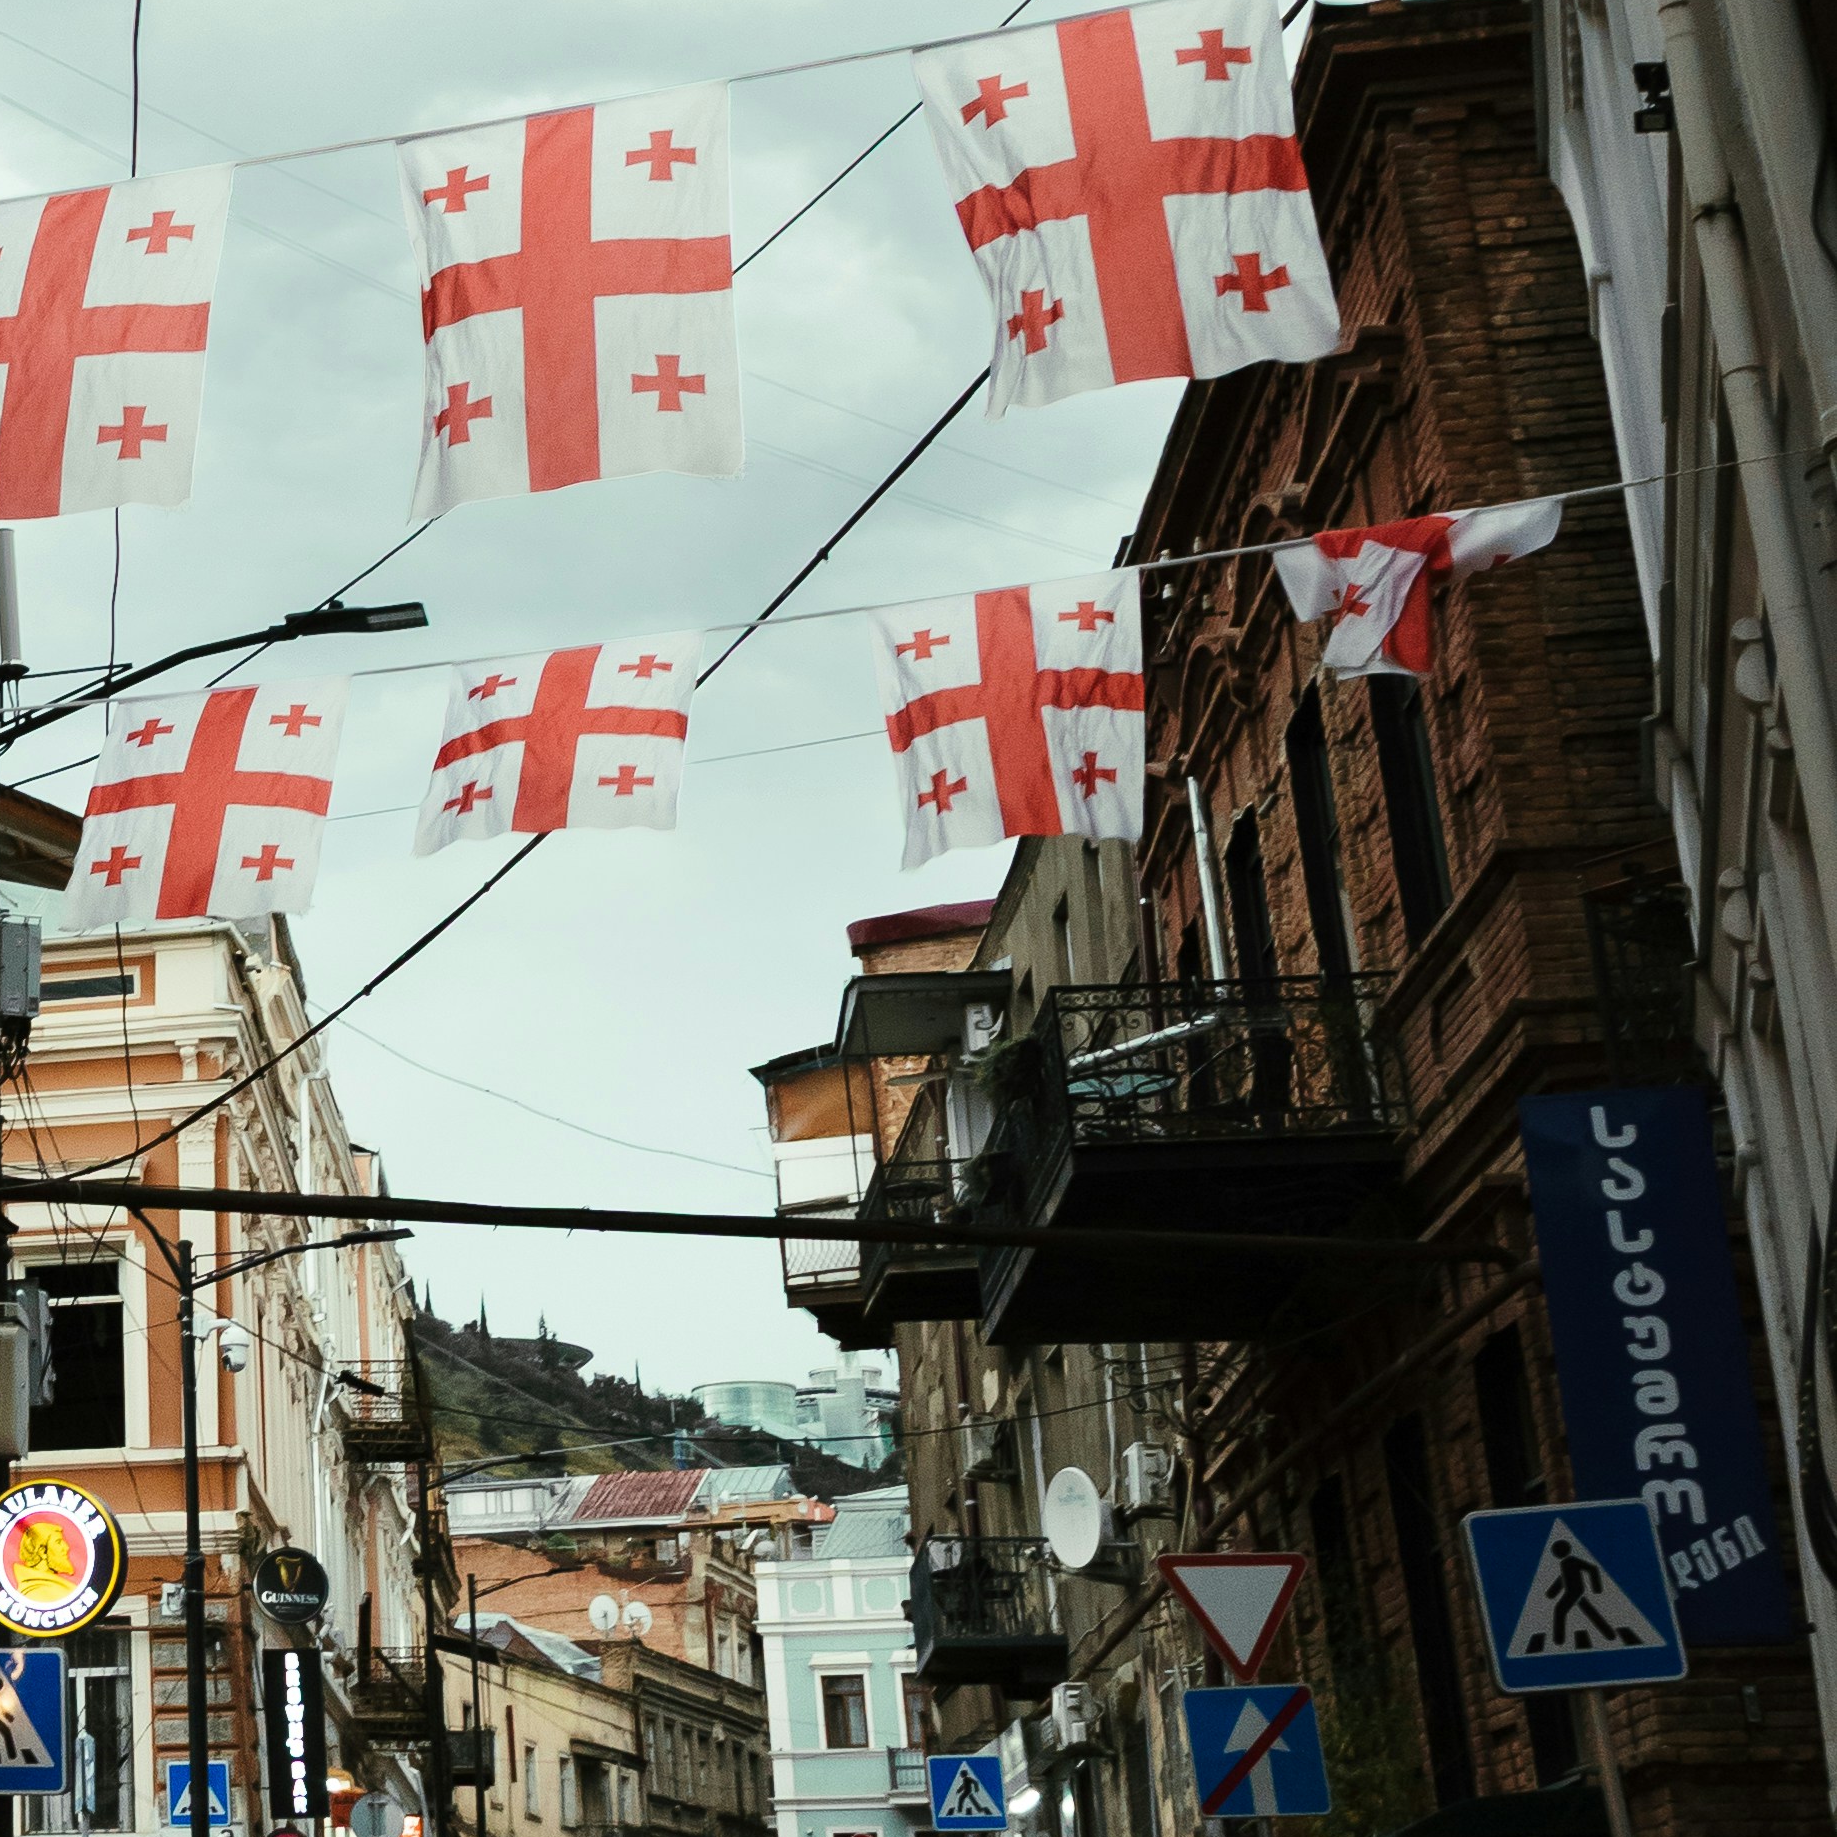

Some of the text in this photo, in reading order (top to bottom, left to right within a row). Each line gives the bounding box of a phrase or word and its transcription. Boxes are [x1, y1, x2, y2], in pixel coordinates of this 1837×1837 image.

[1589, 1105, 1706, 1525] სასტუმრო
[1667, 1514, 1767, 1591] დენი
[261, 1590, 320, 1604] GUINNESS
[290, 1759, 308, 1814] BAR
